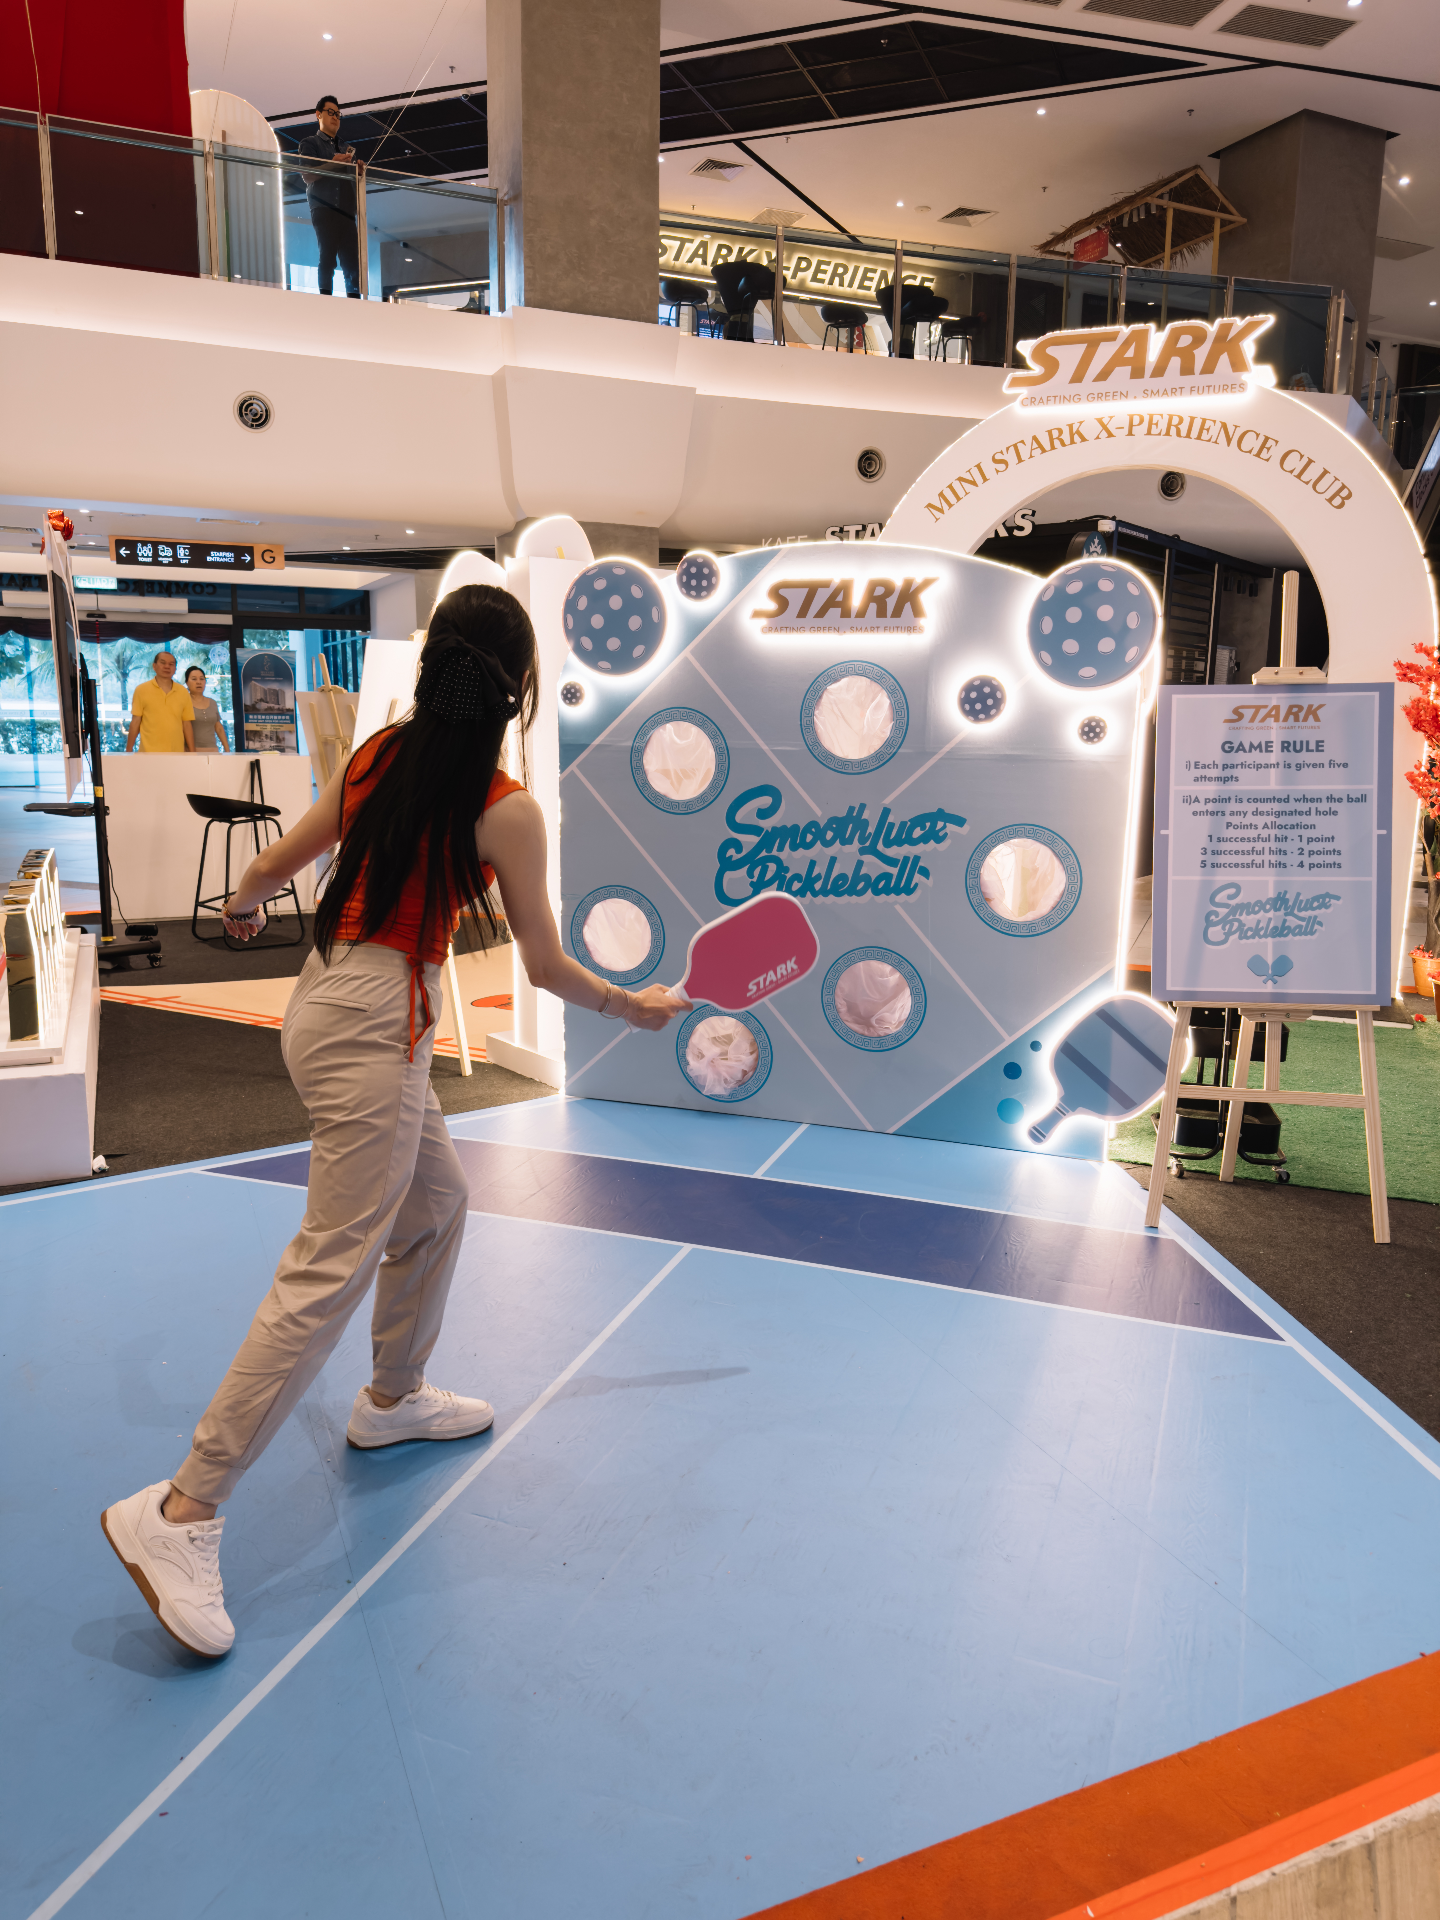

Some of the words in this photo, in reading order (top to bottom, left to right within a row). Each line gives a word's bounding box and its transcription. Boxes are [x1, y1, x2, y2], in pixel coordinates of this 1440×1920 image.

[1008, 319, 1271, 388] STARK
[1021, 393, 1081, 408] CRAFTING
[1086, 391, 1129, 403] GREEN
[1142, 387, 1186, 399] SMART
[1189, 383, 1246, 396] FUTURES
[924, 462, 991, 523] MINI
[991, 422, 1089, 473] STARK
[1094, 413, 1279, 462] X-PERIENCE
[1279, 448, 1354, 511] CLUB
[261, 549, 276, 564] G
[749, 577, 940, 619] STARK
[760, 626, 806, 634] CRAFTING
[809, 626, 840, 634] GREEN
[850, 626, 880, 634] SMART
[883, 625, 925, 634] FUTURES
[1222, 703, 1326, 723] STARK
[1221, 740, 1274, 753] GAME
[1281, 739, 1325, 753] RULE
[1185, 760, 1191, 771] i)
[1194, 760, 1219, 770] Each
[1222, 760, 1280, 771] participant
[1283, 760, 1292, 769] is
[1295, 760, 1324, 771] given
[1328, 759, 1349, 769] five
[1193, 773, 1239, 785] attempts
[1204, 795, 1231, 806] point
[1235, 795, 1243, 804] is
[1247, 794, 1290, 804] counted
[1293, 794, 1323, 804] when
[1326, 794, 1344, 803] the
[1346, 794, 1367, 803] ball
[1192, 808, 1226, 817] enters
[1229, 809, 1248, 819] any
[1251, 807, 1312, 819] designated
[1315, 807, 1339, 817] hole
[717, 784, 873, 871] Smooth
[1225, 821, 1259, 830] Points
[1262, 821, 1316, 831] Allocation
[1207, 834, 1213, 843] 1
[1216, 834, 1271, 843] successful
[1274, 834, 1288, 843] hit
[1297, 834, 1302, 843] 1
[1307, 834, 1335, 844] point
[1200, 847, 1208, 856] 3
[1210, 847, 1266, 856] successful
[1268, 847, 1288, 856] hits
[1297, 847, 1304, 856] 2
[1308, 847, 1342, 857] points
[1199, 860, 1207, 869] 5
[1210, 860, 1266, 869] successful
[1268, 860, 1288, 869] hits
[1297, 860, 1305, 869] 4
[1308, 860, 1342, 870] points
[714, 854, 931, 907] Pickleball
[1204, 882, 1290, 926] Smooth
[1203, 917, 1323, 946] Pickleball
[747, 955, 798, 997] STARK
